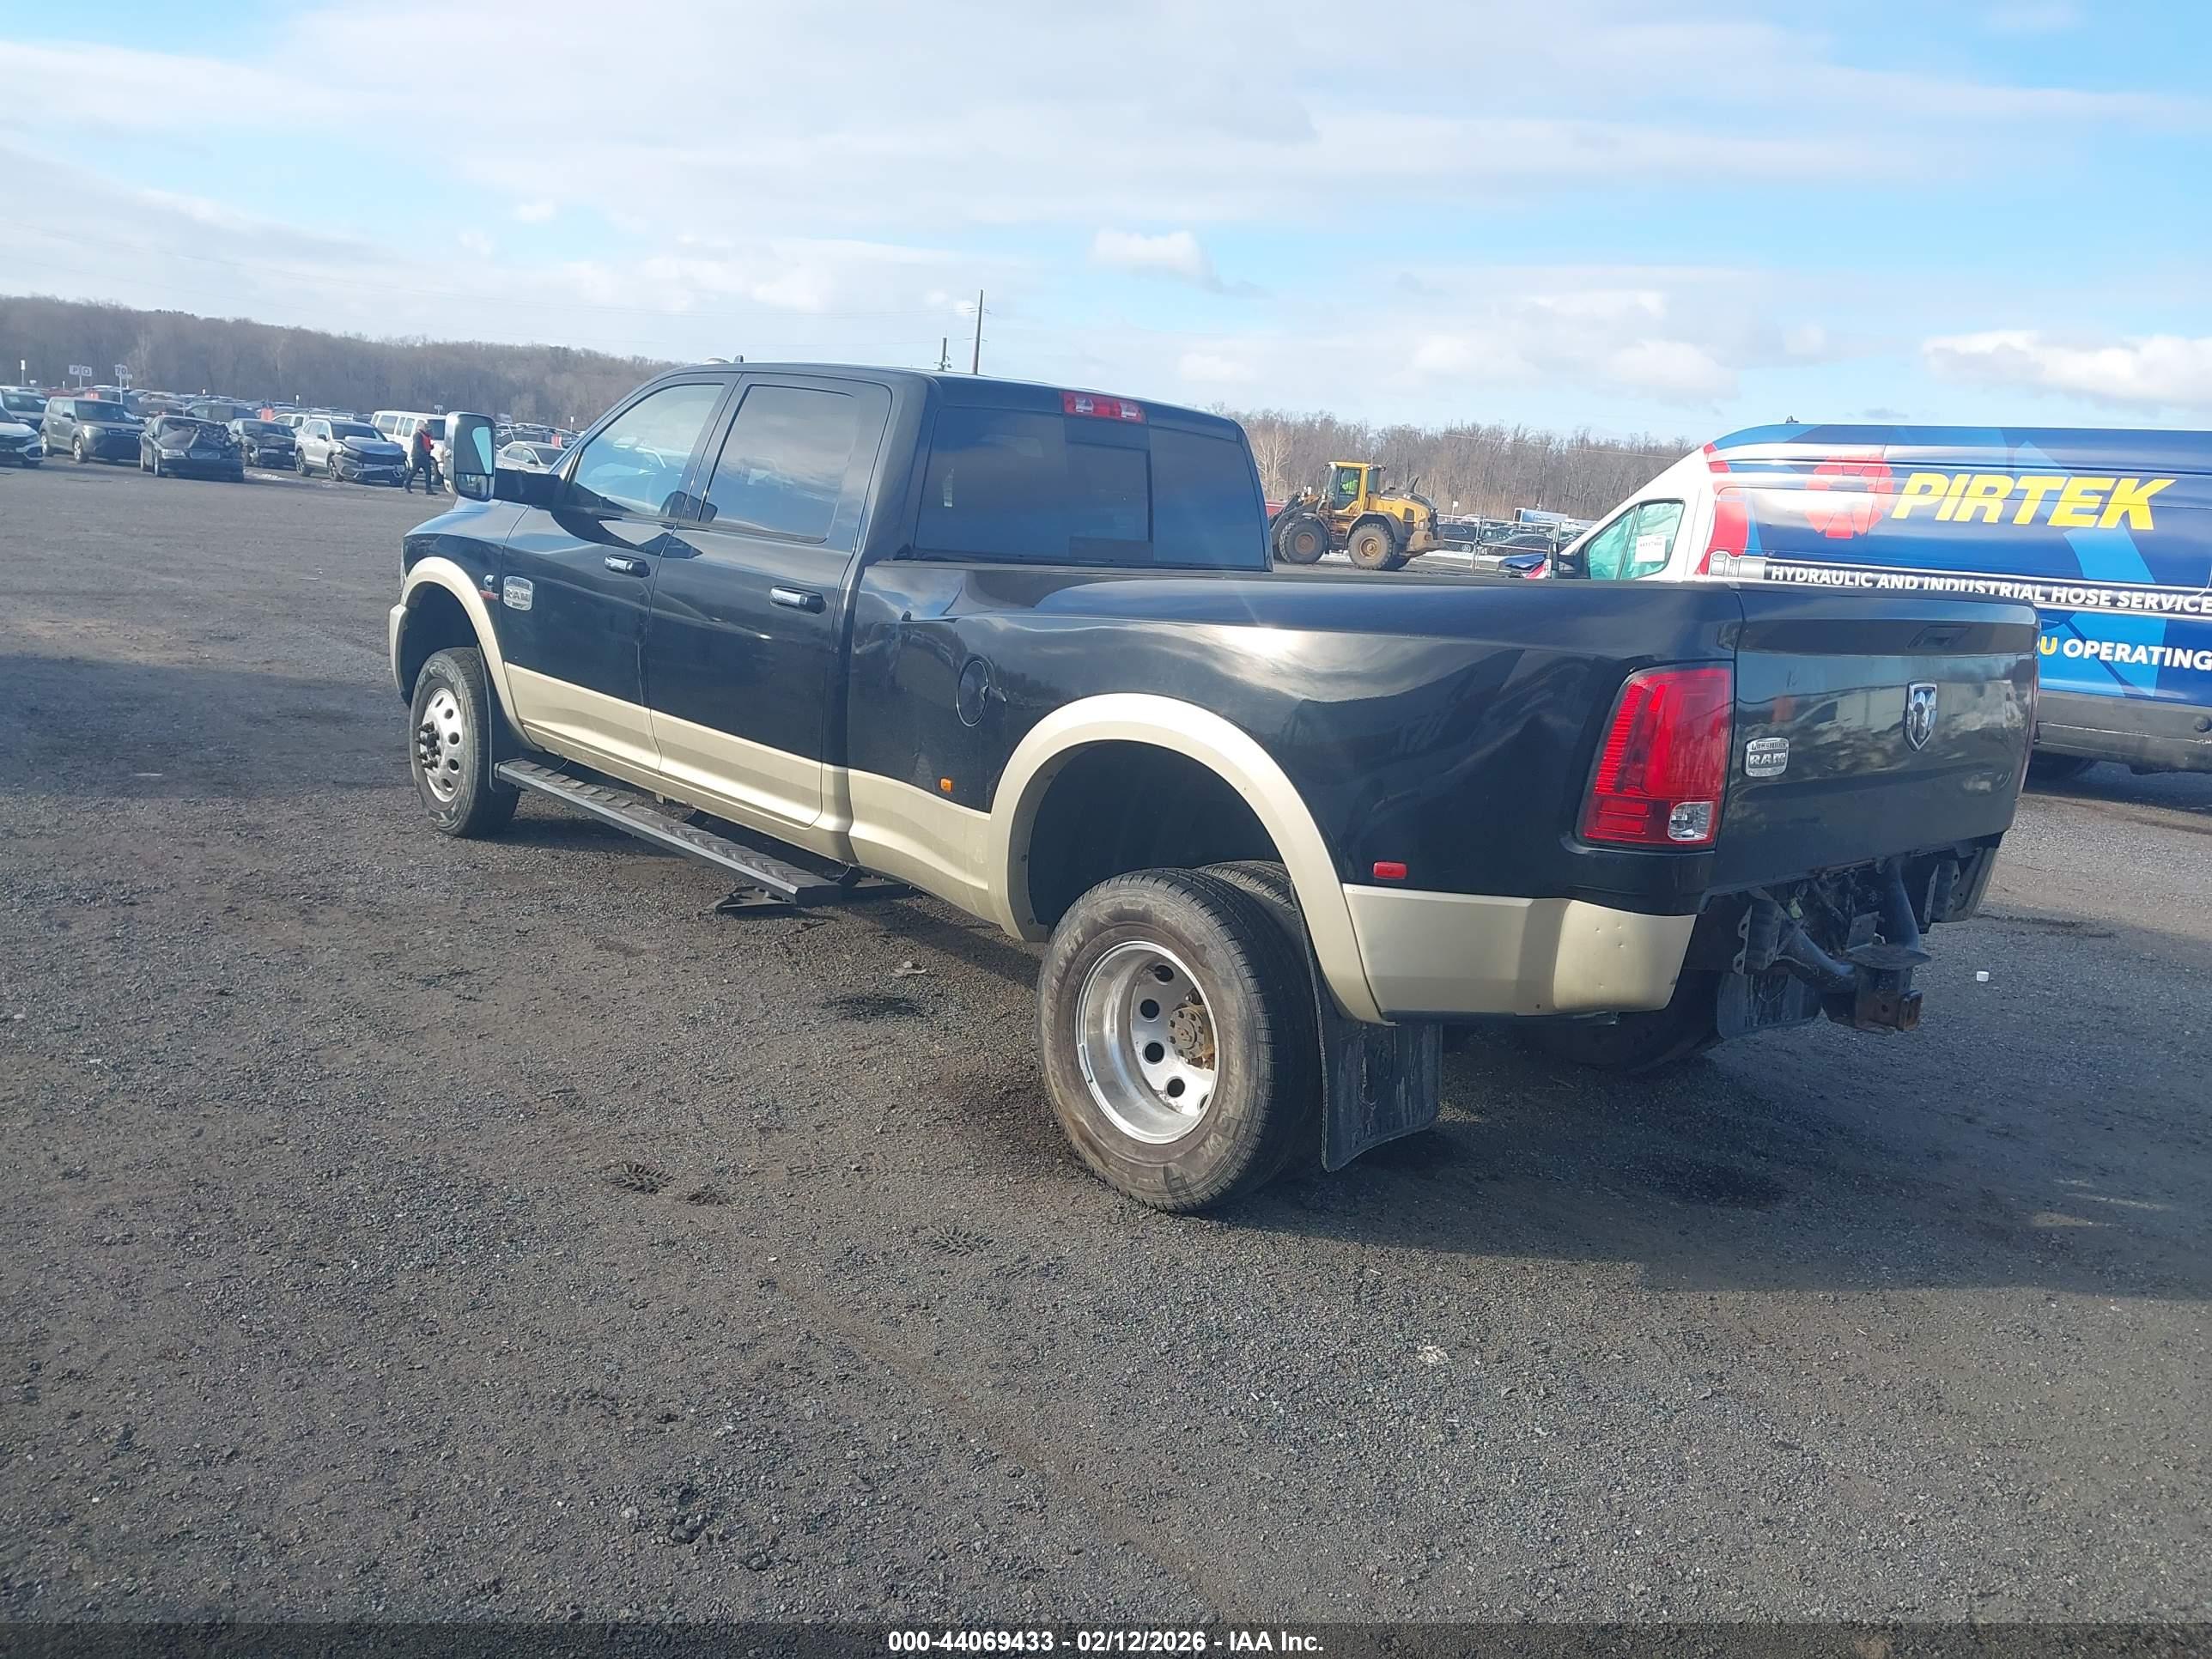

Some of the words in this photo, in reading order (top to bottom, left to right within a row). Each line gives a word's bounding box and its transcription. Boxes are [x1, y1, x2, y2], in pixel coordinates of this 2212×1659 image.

[1890, 472, 2178, 531] PIRTEK
[1771, 565, 1873, 588] HYDRAULIC
[1876, 574, 1918, 590] AND
[1923, 576, 2046, 601] INDUSTRIAL
[2051, 586, 2112, 607] HOSE
[2038, 635, 2058, 655] U
[2063, 638, 2212, 672] OPERATING
[1749, 752, 1786, 765] RAM
